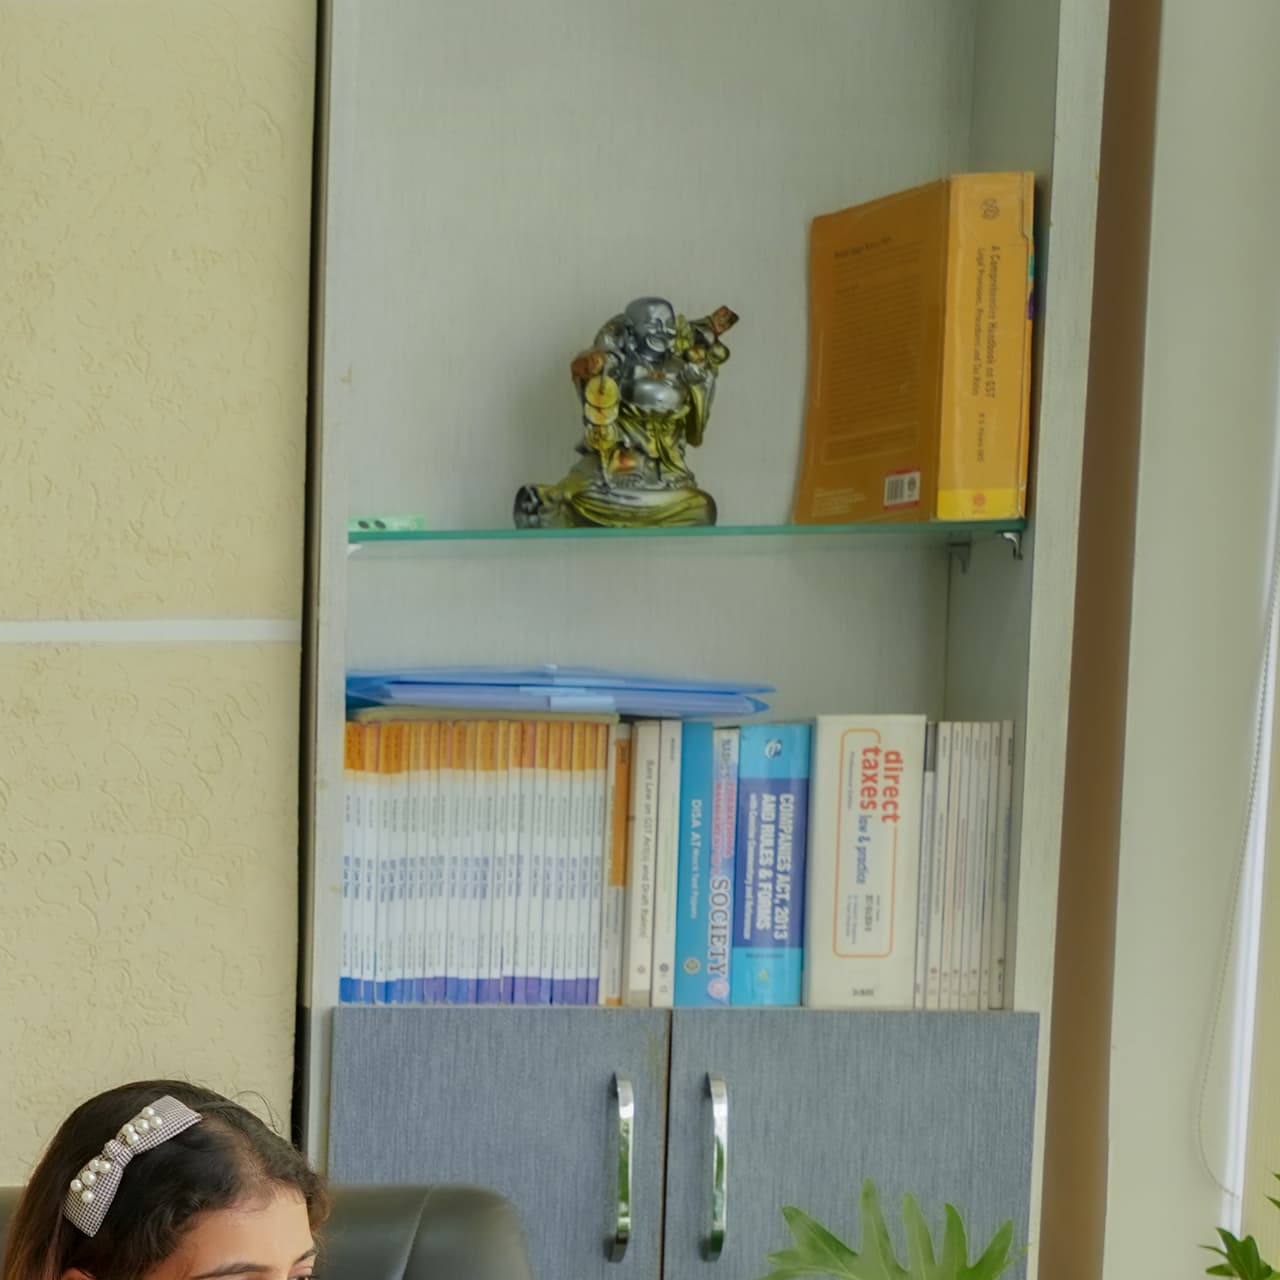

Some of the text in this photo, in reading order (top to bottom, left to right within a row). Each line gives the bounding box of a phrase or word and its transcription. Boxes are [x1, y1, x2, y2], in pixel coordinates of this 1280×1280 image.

[859, 745, 882, 811] taxes
[882, 750, 905, 824] direct
[858, 814, 873, 833] law
[756, 793, 777, 930] AND RULES & FORMS
[772, 793, 795, 941] COMPANIES ACT, 2013
[855, 845, 870, 885] practice
[710, 877, 730, 977] SOCIETY
